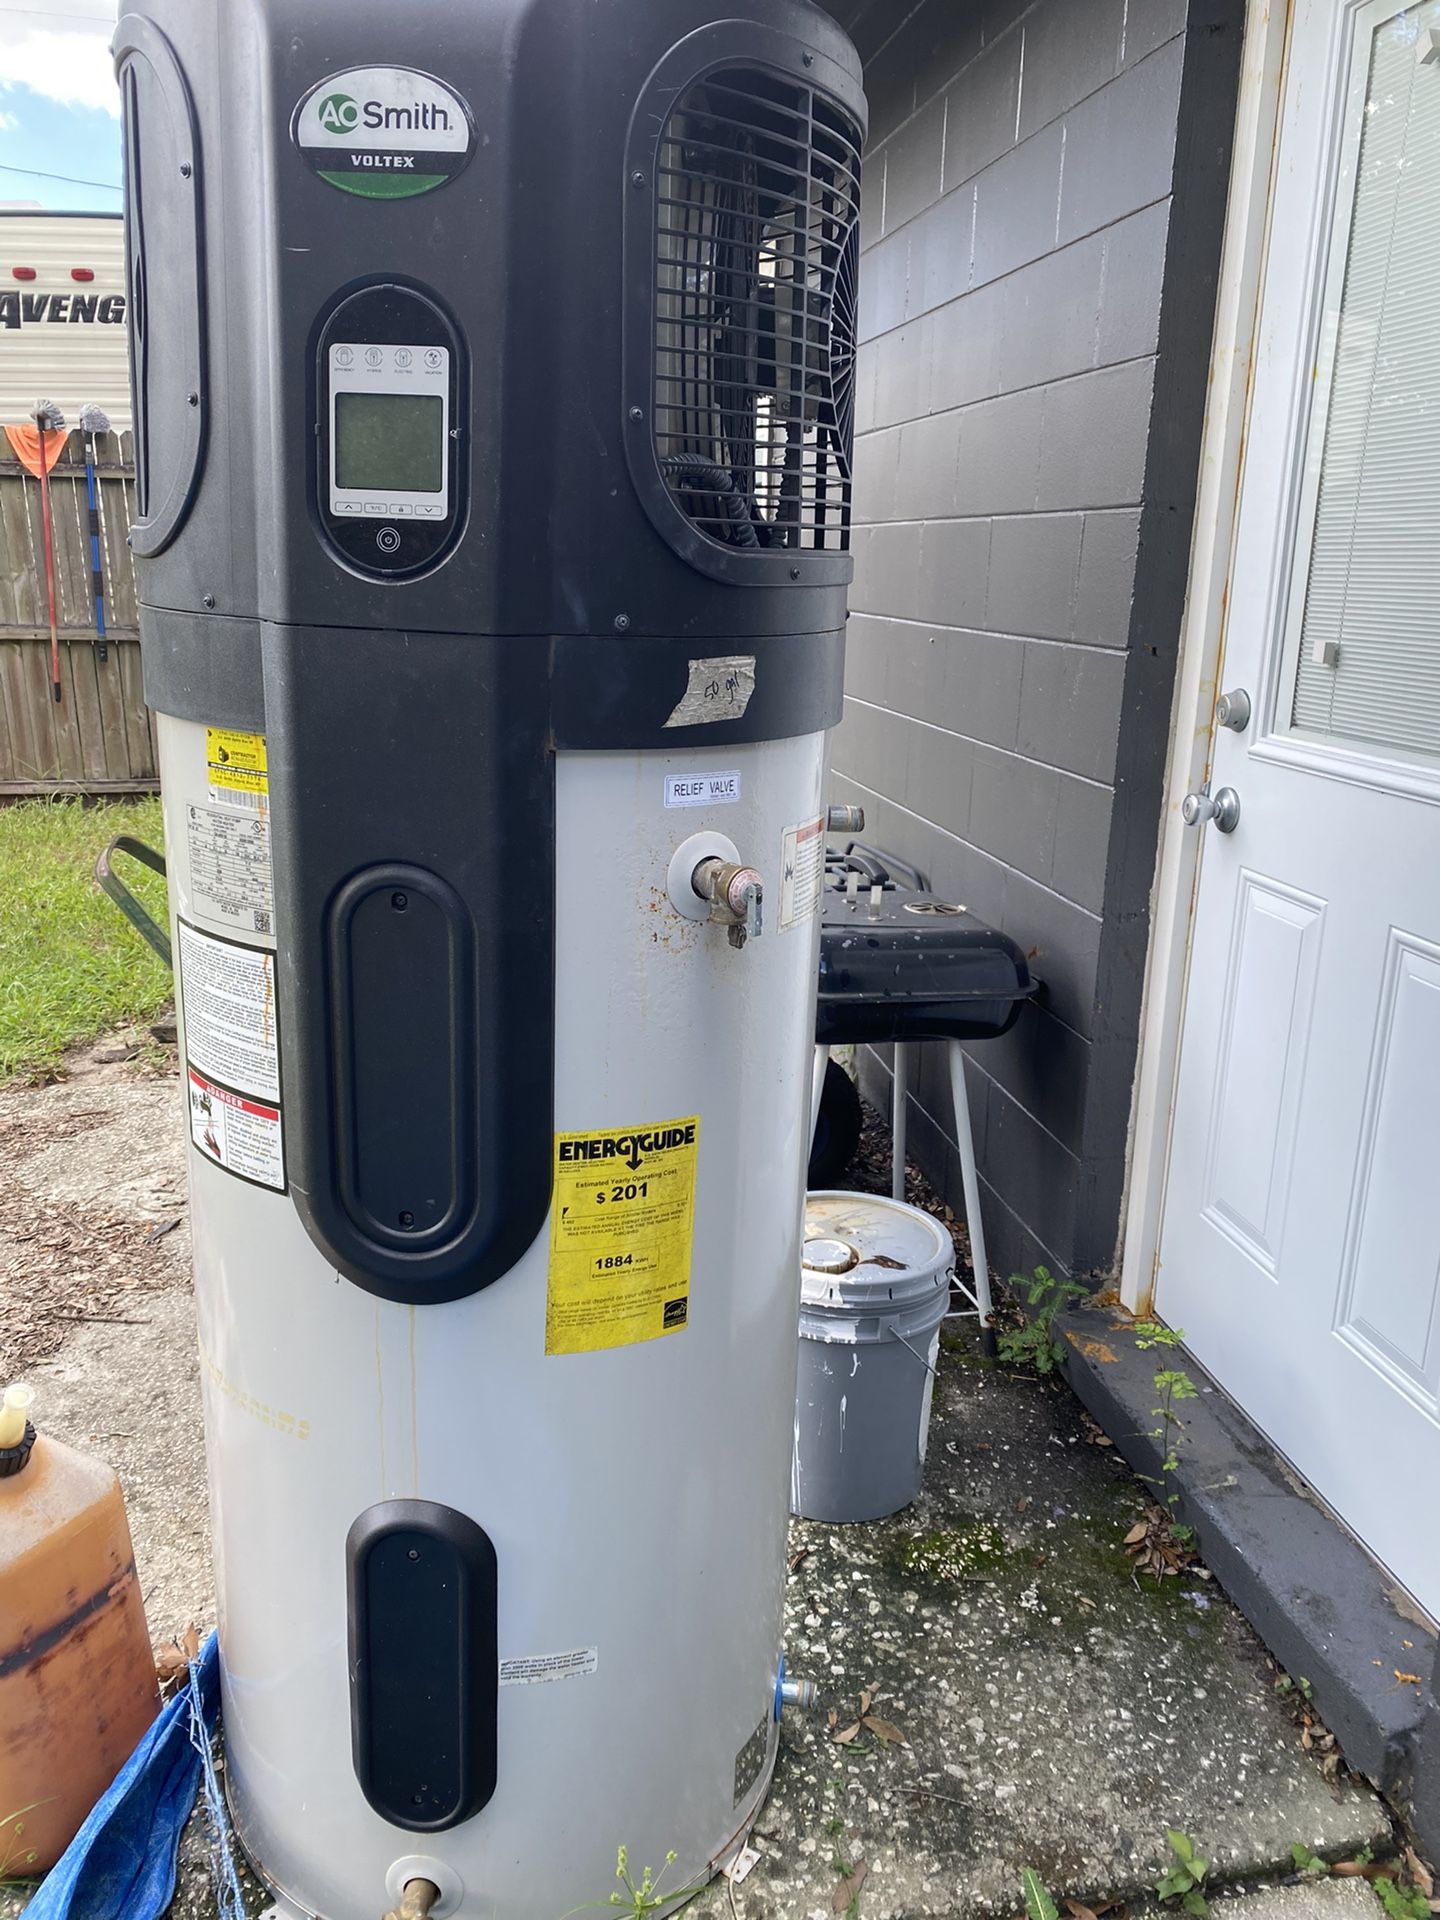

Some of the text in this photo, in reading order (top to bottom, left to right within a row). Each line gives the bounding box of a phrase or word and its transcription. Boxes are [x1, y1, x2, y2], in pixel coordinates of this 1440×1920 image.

[351, 154, 415, 168] VOLTEX
[0, 290, 126, 329] AVENG
[674, 782, 705, 797] RELIEF
[709, 779, 735, 794] VALVE
[211, 1086, 244, 1109] DANGER
[559, 1124, 696, 1163] ENERGYGUIDE
[575, 1168, 678, 1188] Estimated Yearly Operating Cost
[596, 1182, 649, 1205] $ 201
[595, 1254, 633, 1270] 1884
